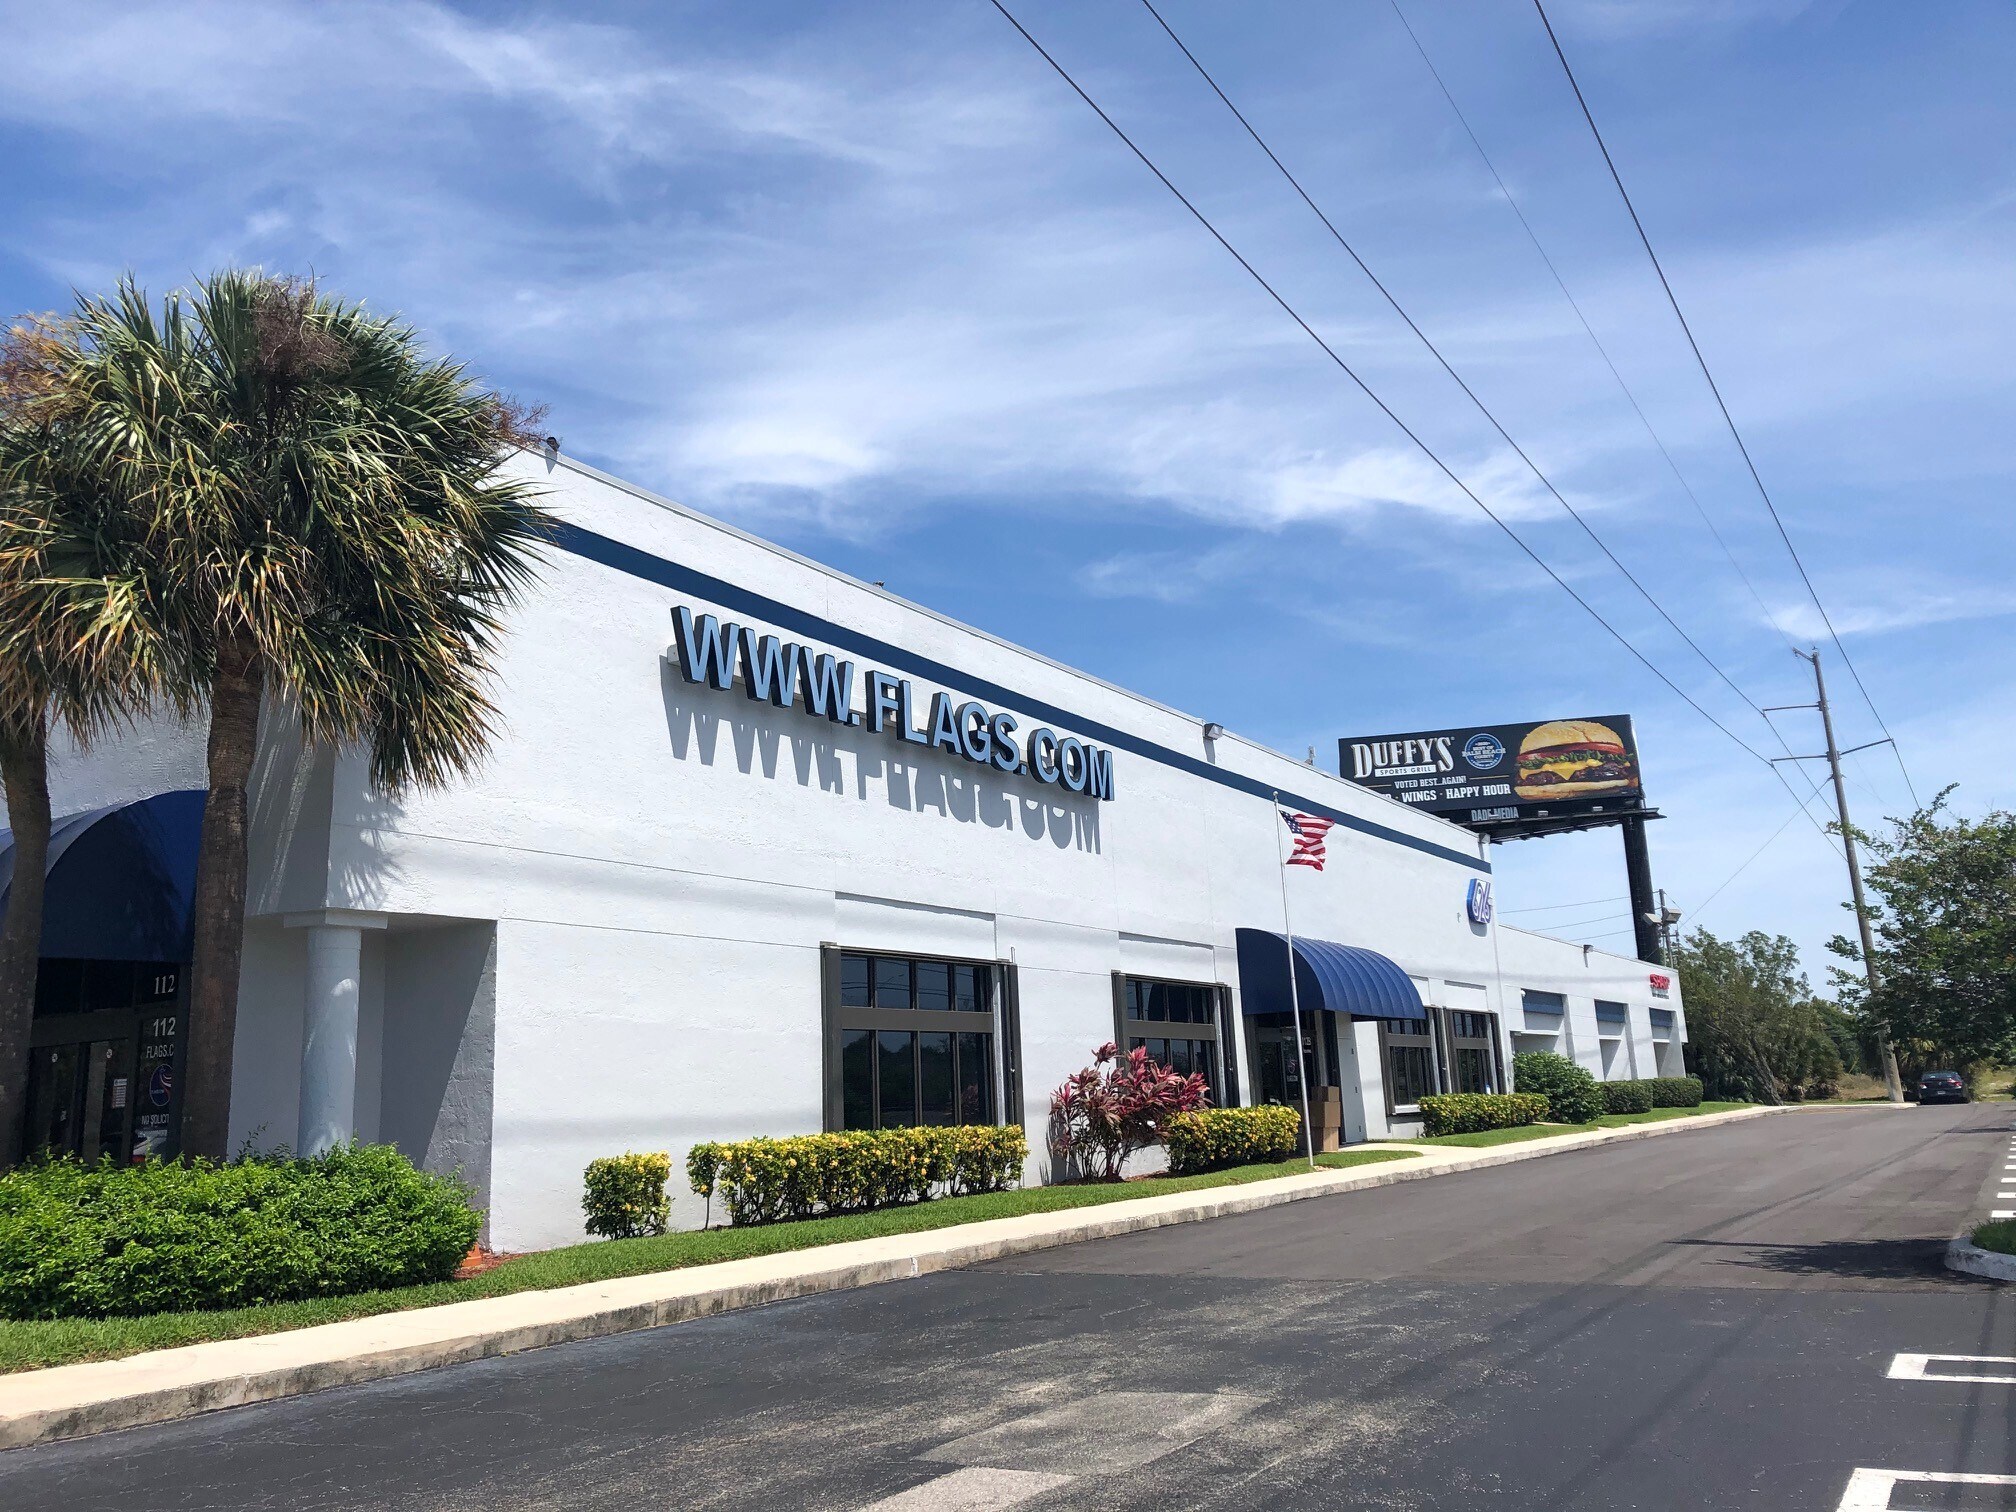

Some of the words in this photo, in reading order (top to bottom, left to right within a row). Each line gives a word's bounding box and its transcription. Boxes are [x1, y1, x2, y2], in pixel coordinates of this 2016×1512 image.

[670, 605, 1115, 801] WWW.FLAGS.COM
[1380, 768, 1408, 776] SPORTS
[1394, 780, 1418, 789] VOTED
[1401, 790, 1437, 803] WINGS
[1445, 786, 1480, 799] HAPPY
[1482, 783, 1512, 796] HOUR
[154, 974, 176, 995] 112
[153, 1016, 176, 1037] 112
